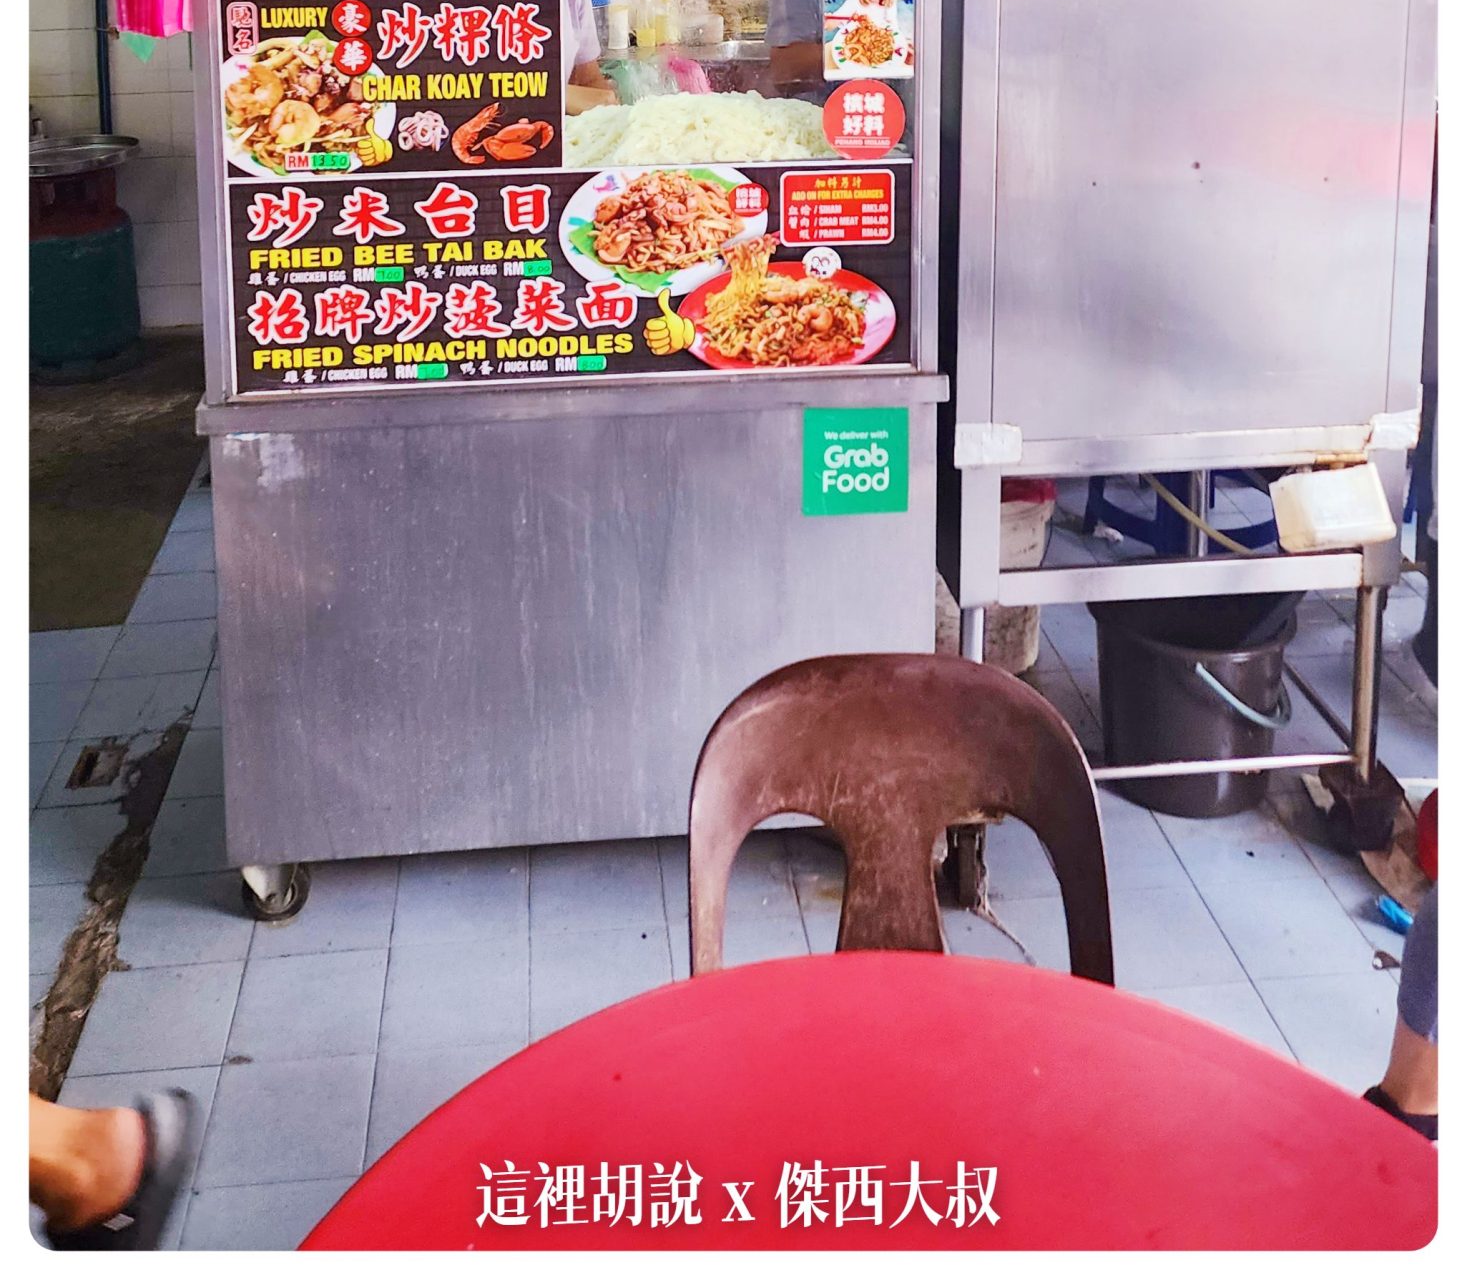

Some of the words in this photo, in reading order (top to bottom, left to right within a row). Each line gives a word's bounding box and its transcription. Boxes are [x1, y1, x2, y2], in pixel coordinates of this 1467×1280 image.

[260, 6, 329, 29] LUXURY
[338, 1, 368, 72] 豪華
[377, 2, 552, 68] 炒粿條
[362, 75, 422, 102] CHAR
[427, 73, 483, 100] KOAY
[489, 71, 549, 99] TEOW
[791, 191, 806, 201] ADD
[806, 190, 817, 200] ON
[817, 190, 831, 200] FOR
[831, 189, 853, 200] EXTRA
[248, 182, 551, 247] 炒米台目
[818, 216, 839, 226] CRAB
[838, 216, 859, 226] MEAT
[250, 246, 344, 270] FRIED
[353, 244, 415, 266] BEE
[423, 242, 473, 263] TAI
[483, 238, 548, 260] BAK
[289, 271, 327, 283] CHICKEN
[328, 270, 347, 282] EGG
[456, 265, 479, 277] DUCK
[480, 264, 498, 276] EGG
[249, 278, 637, 344] 招牌炒菠菜面
[252, 346, 344, 371] FRIED
[352, 339, 486, 365] SPINACH
[496, 333, 634, 358] NOODLES
[504, 360, 530, 373] DUCK
[530, 359, 549, 372] EGG
[823, 430, 839, 440] We
[839, 430, 869, 440] deliver
[869, 429, 889, 439] with
[823, 442, 890, 470] Grab
[822, 465, 891, 494] Food
